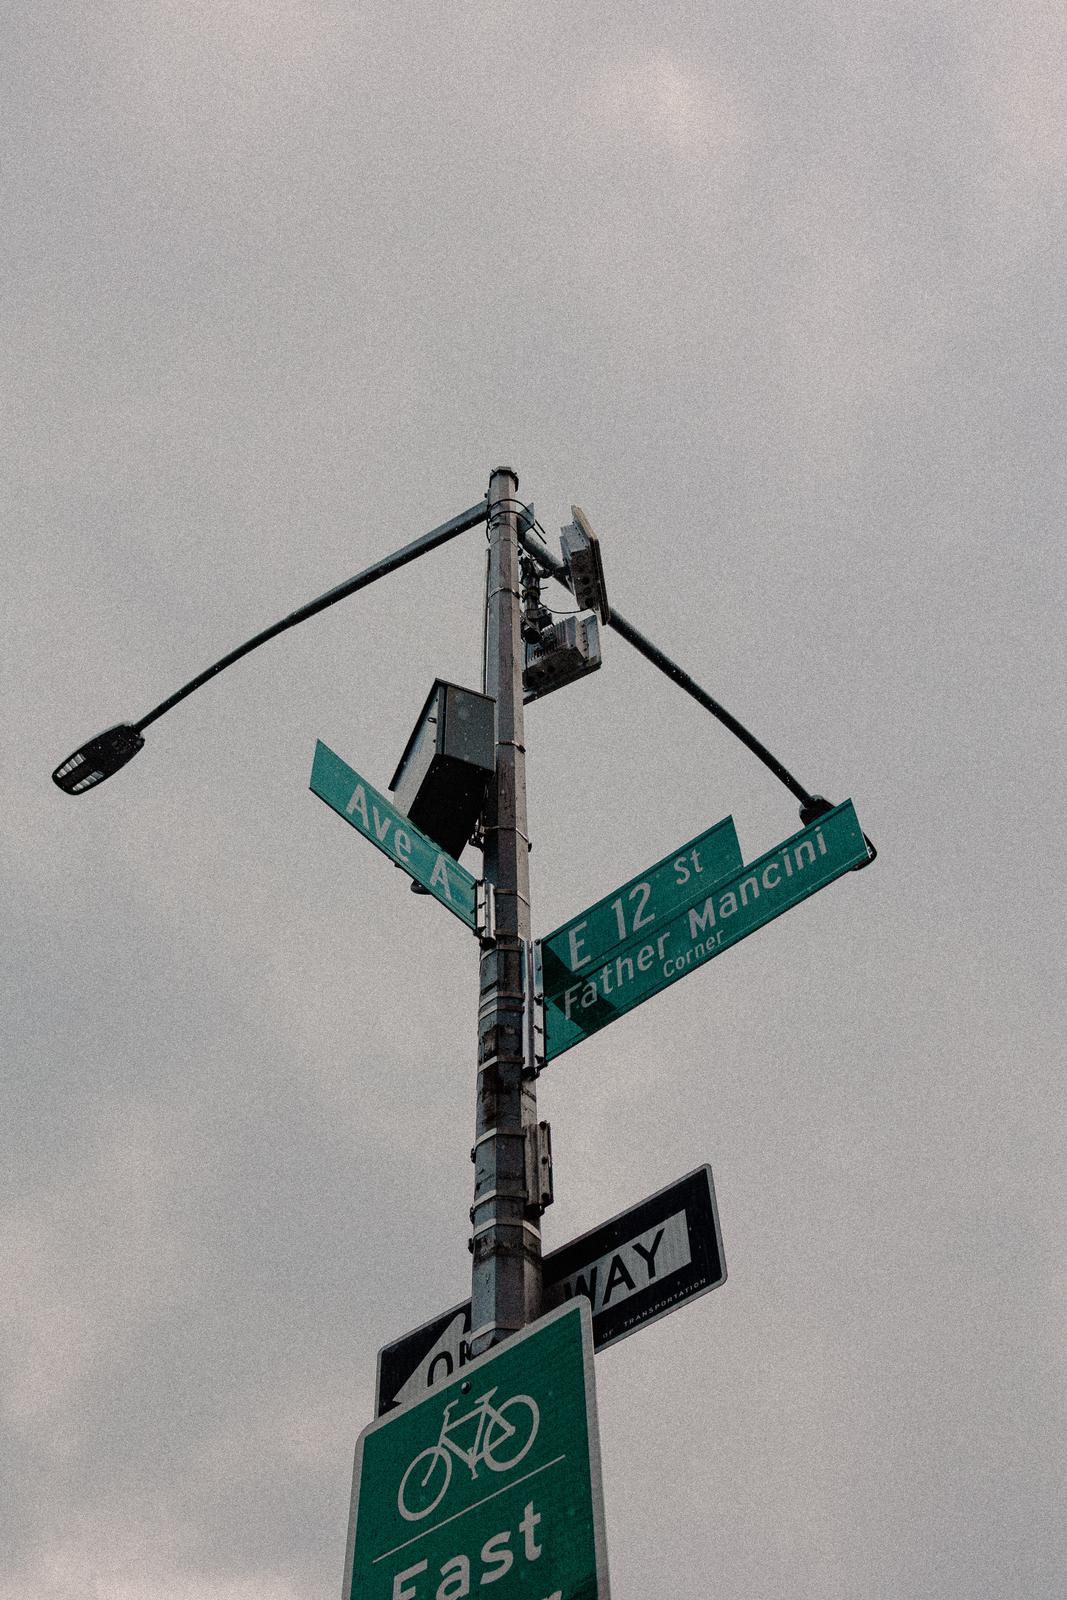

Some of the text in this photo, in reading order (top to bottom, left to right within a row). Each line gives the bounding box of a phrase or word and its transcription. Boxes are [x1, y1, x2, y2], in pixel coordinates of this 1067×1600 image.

[345, 784, 453, 901] Ave A
[562, 825, 829, 1021] Father Mancini
[568, 848, 704, 973] E 12 St
[662, 929, 725, 978] Corner
[623, 1278, 707, 1328] TRANSPORTATION
